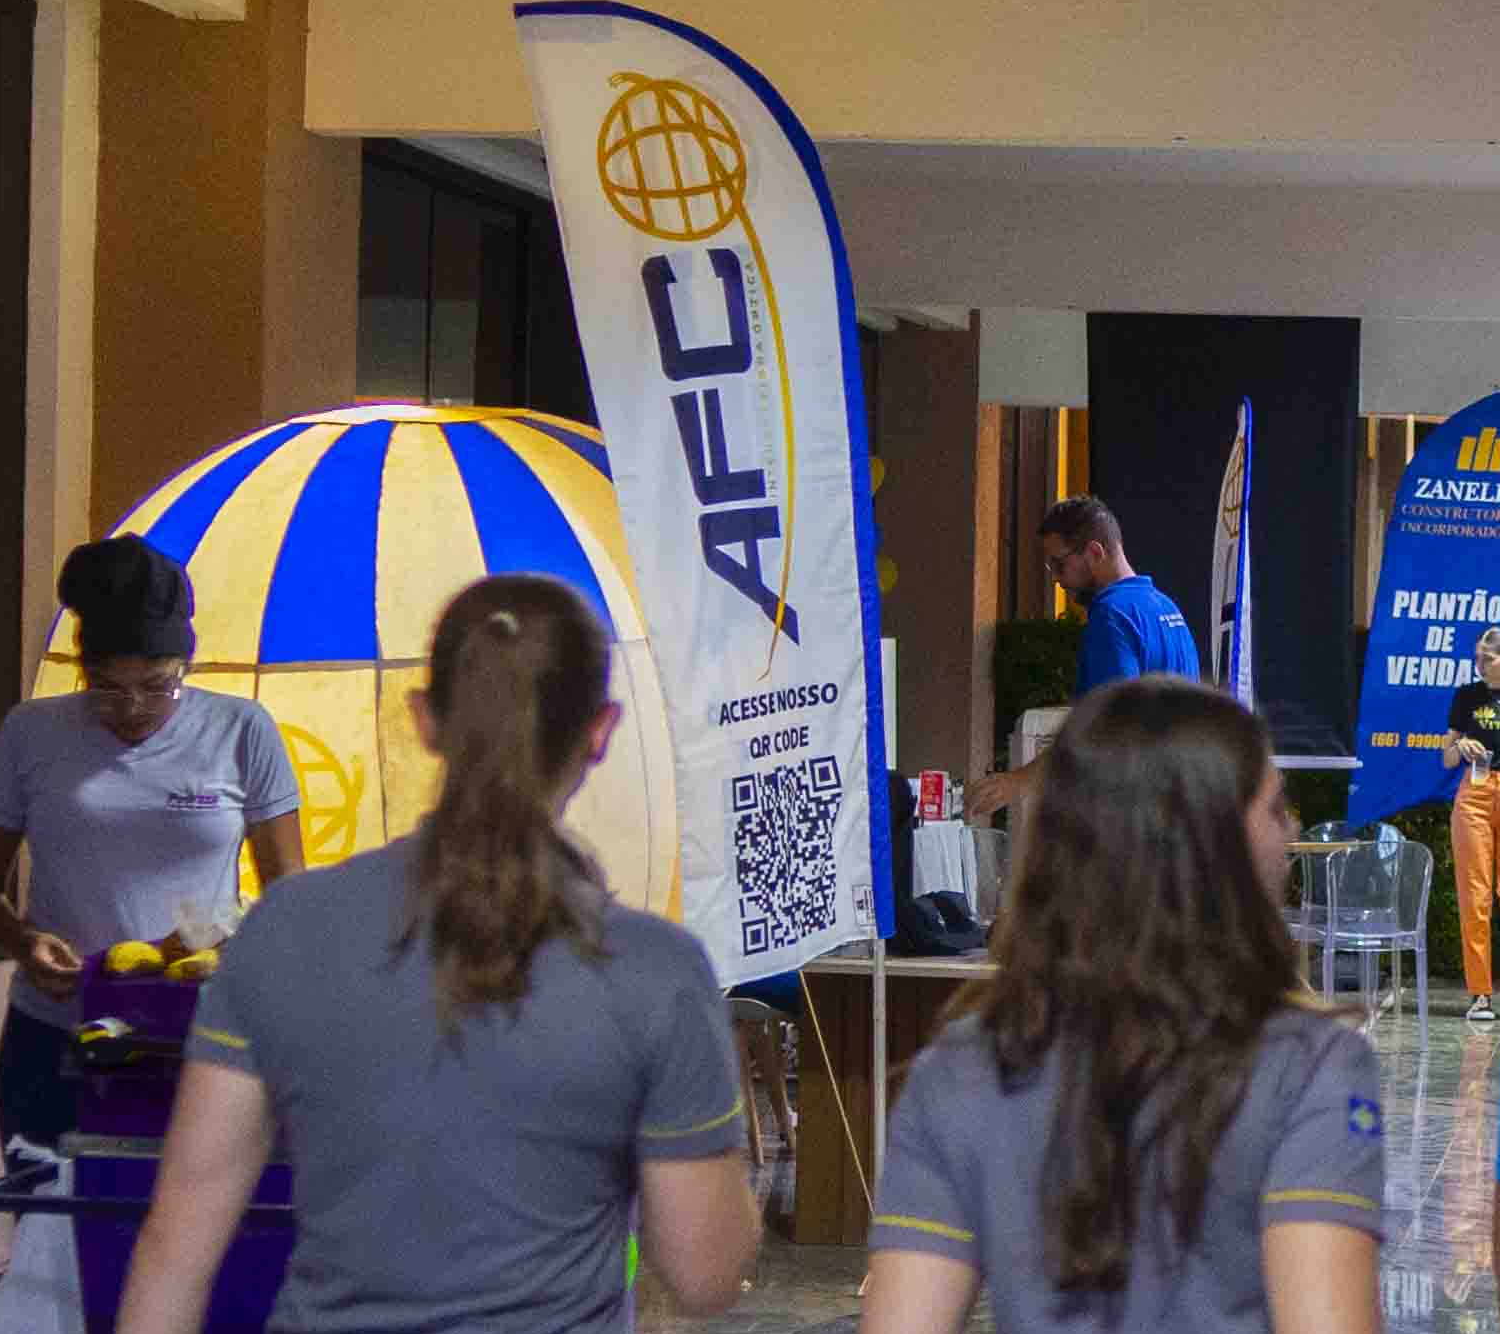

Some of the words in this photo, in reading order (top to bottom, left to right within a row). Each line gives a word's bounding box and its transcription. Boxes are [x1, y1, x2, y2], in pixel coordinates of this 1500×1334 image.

[641, 248, 800, 646] AFC
[1425, 626, 1455, 653] DE
[719, 691, 775, 726] ACESSE
[777, 683, 838, 712] NOSSO
[750, 734, 771, 759] QR
[774, 726, 810, 754] CODE
